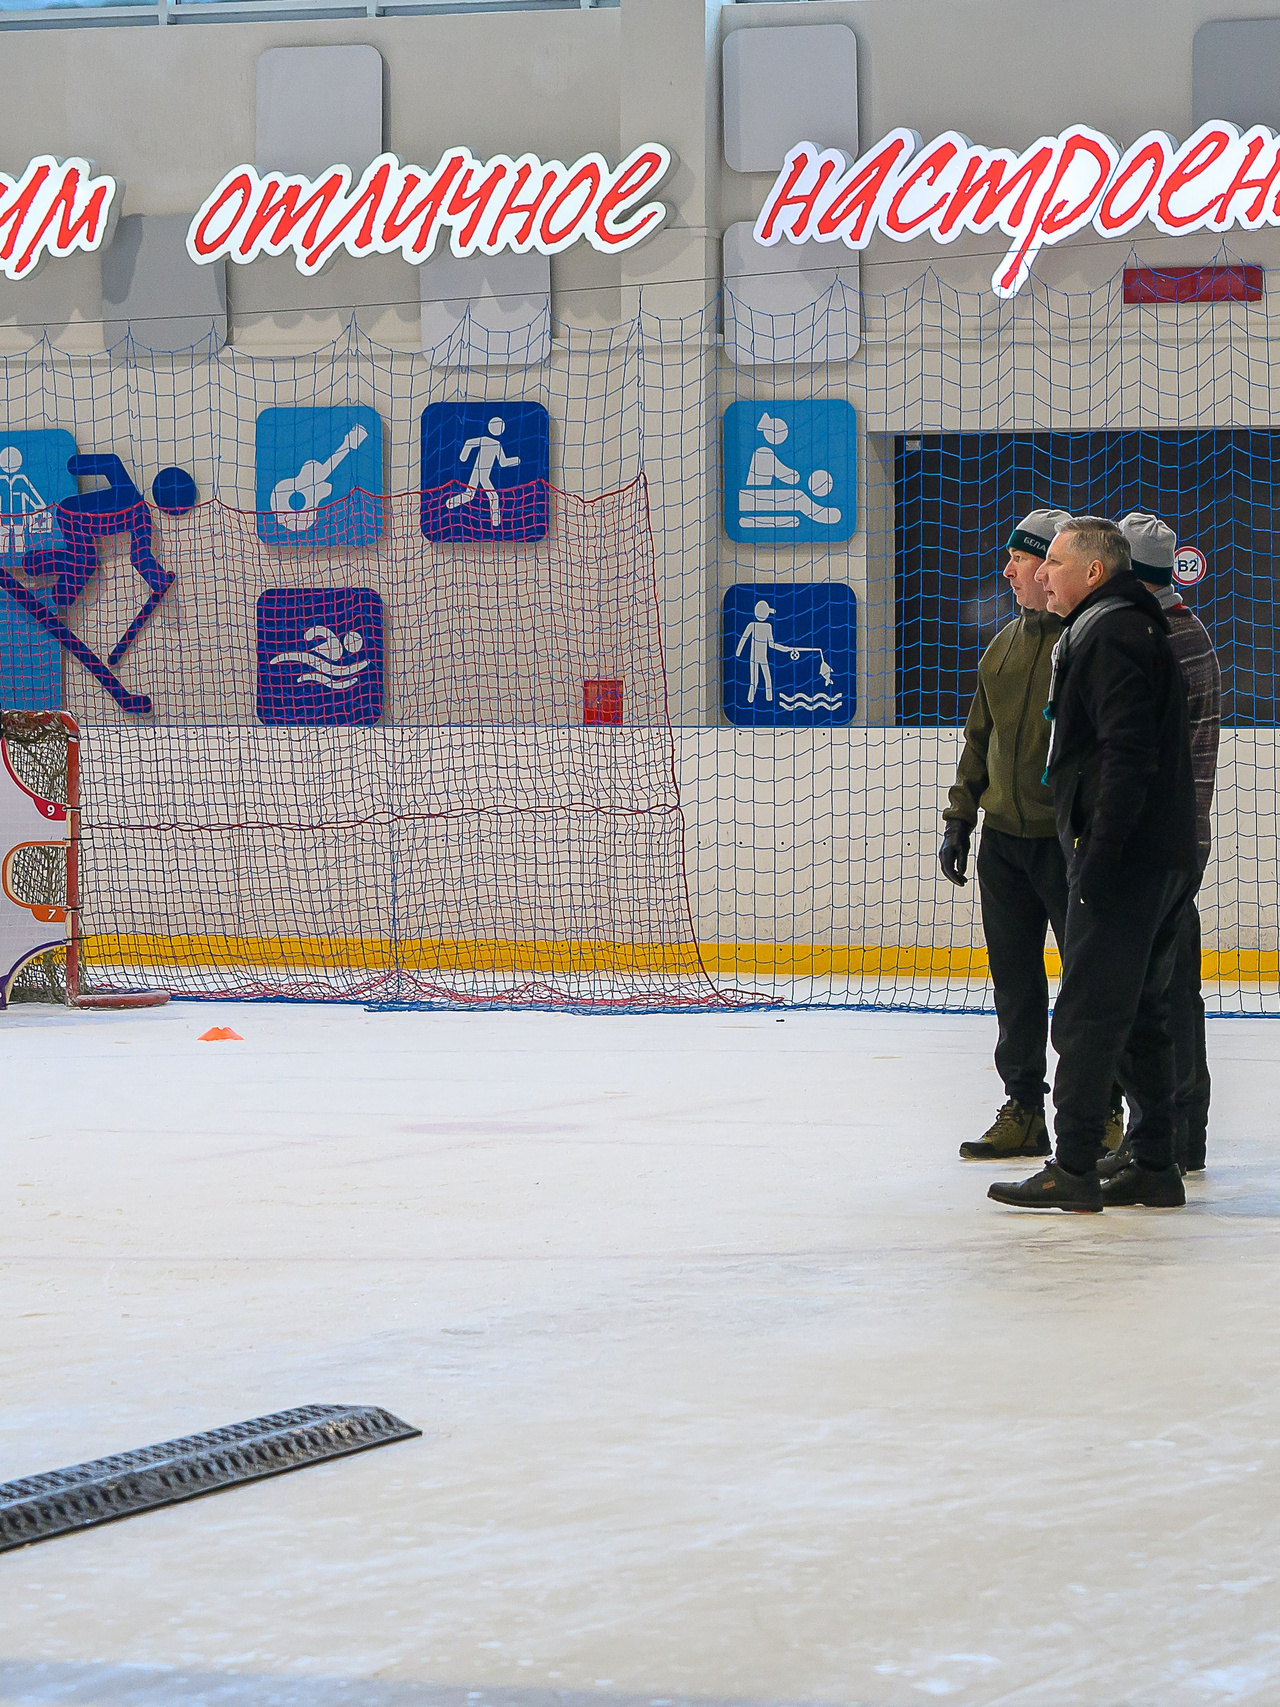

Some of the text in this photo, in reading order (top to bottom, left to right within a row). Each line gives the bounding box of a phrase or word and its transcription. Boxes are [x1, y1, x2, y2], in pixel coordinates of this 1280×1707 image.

[195, 151, 661, 266] отличное
[47, 804, 55, 816] 9
[47, 908, 56, 920] 7
